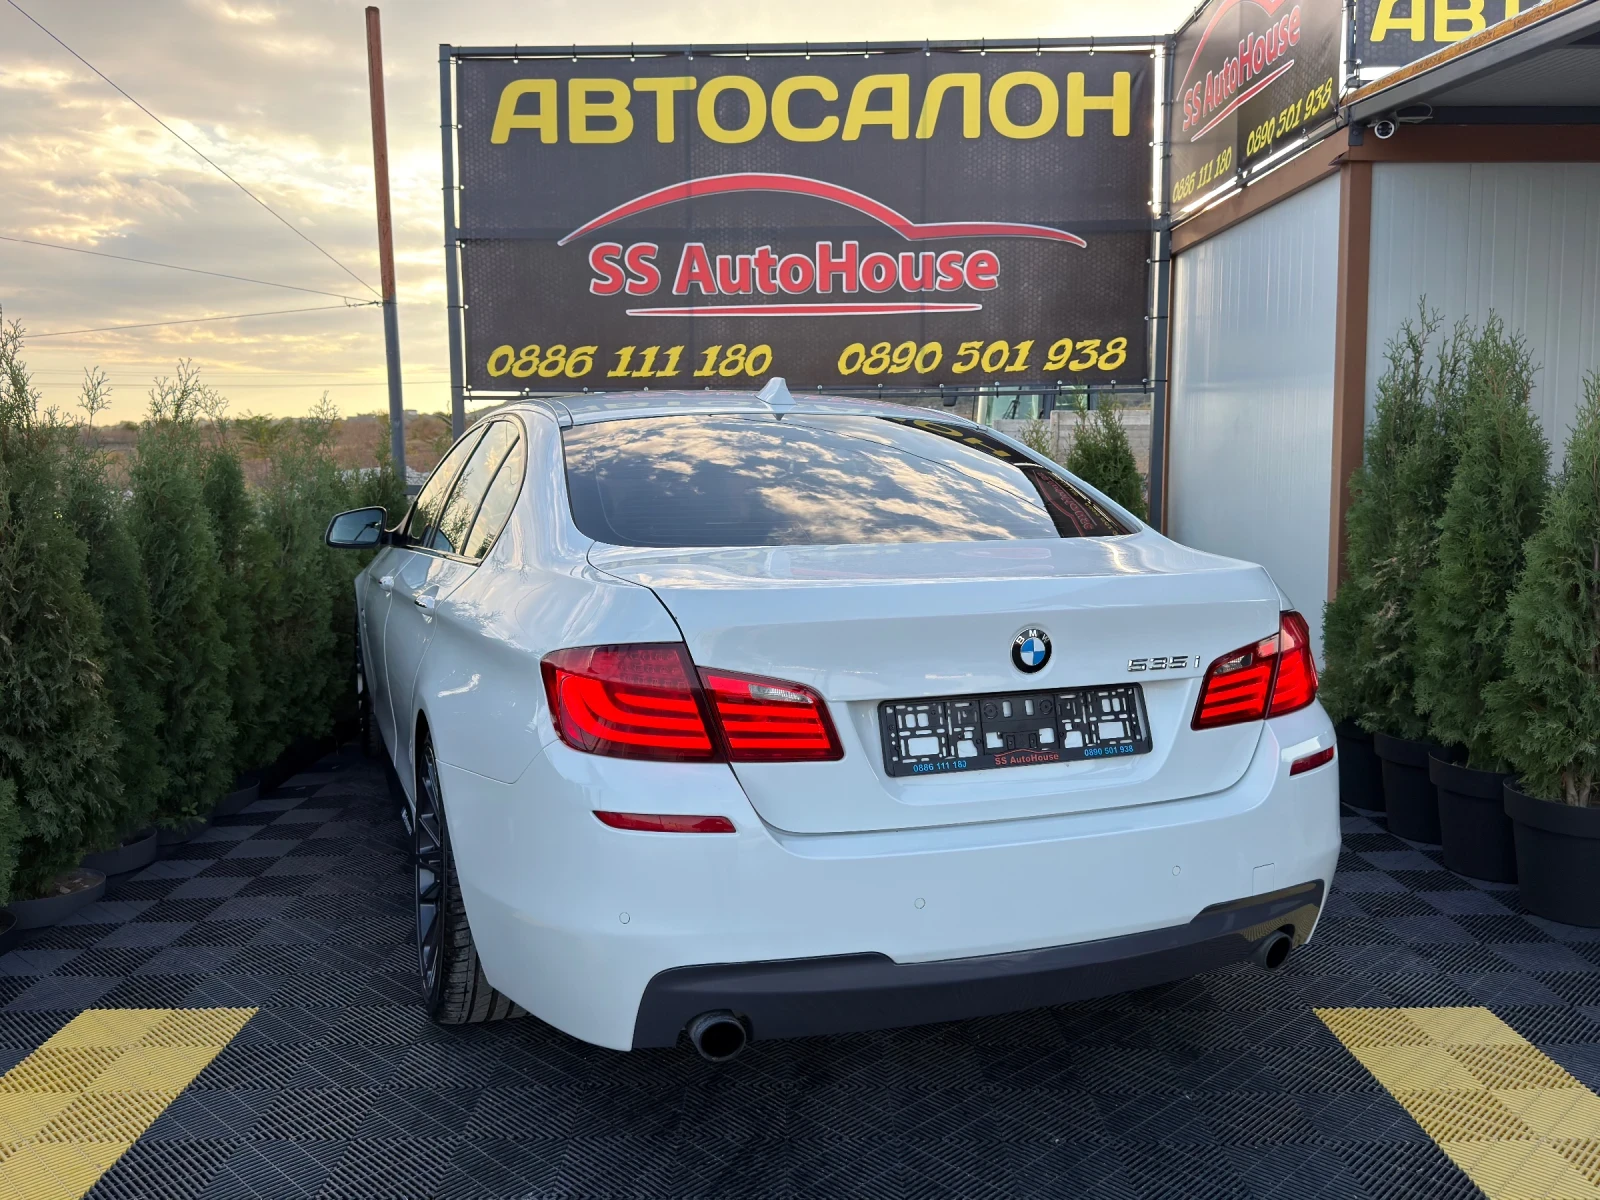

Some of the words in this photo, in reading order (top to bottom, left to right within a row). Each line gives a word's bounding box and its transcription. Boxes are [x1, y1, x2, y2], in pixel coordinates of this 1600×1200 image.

[1182, 81, 1202, 132] SS
[1202, 4, 1300, 118] AutoHouse
[490, 71, 1132, 145] АВТОСАЛОН
[1246, 116, 1276, 157] 0890
[1276, 98, 1303, 138] 501
[1303, 77, 1333, 121] 938
[1172, 171, 1196, 203] 0886
[1196, 161, 1213, 190] 111
[1213, 146, 1233, 178] 180
[588, 242, 661, 296] SS
[672, 241, 1001, 296] AutoHouse
[486, 343, 598, 379] 0886
[606, 344, 684, 378] 111
[694, 343, 773, 378] 180
[837, 341, 944, 376] 0890
[951, 339, 1034, 375] 501
[1043, 336, 1128, 372] 938
[1015, 628, 1051, 646] BMW
[912, 763, 934, 773] 0886
[936, 762, 950, 770] 111
[994, 756, 1007, 766] SS
[1010, 753, 1059, 764] AutoHouse
[1083, 747, 1102, 757] 0890
[1104, 746, 1119, 755] 501
[1119, 744, 1134, 754] 938
